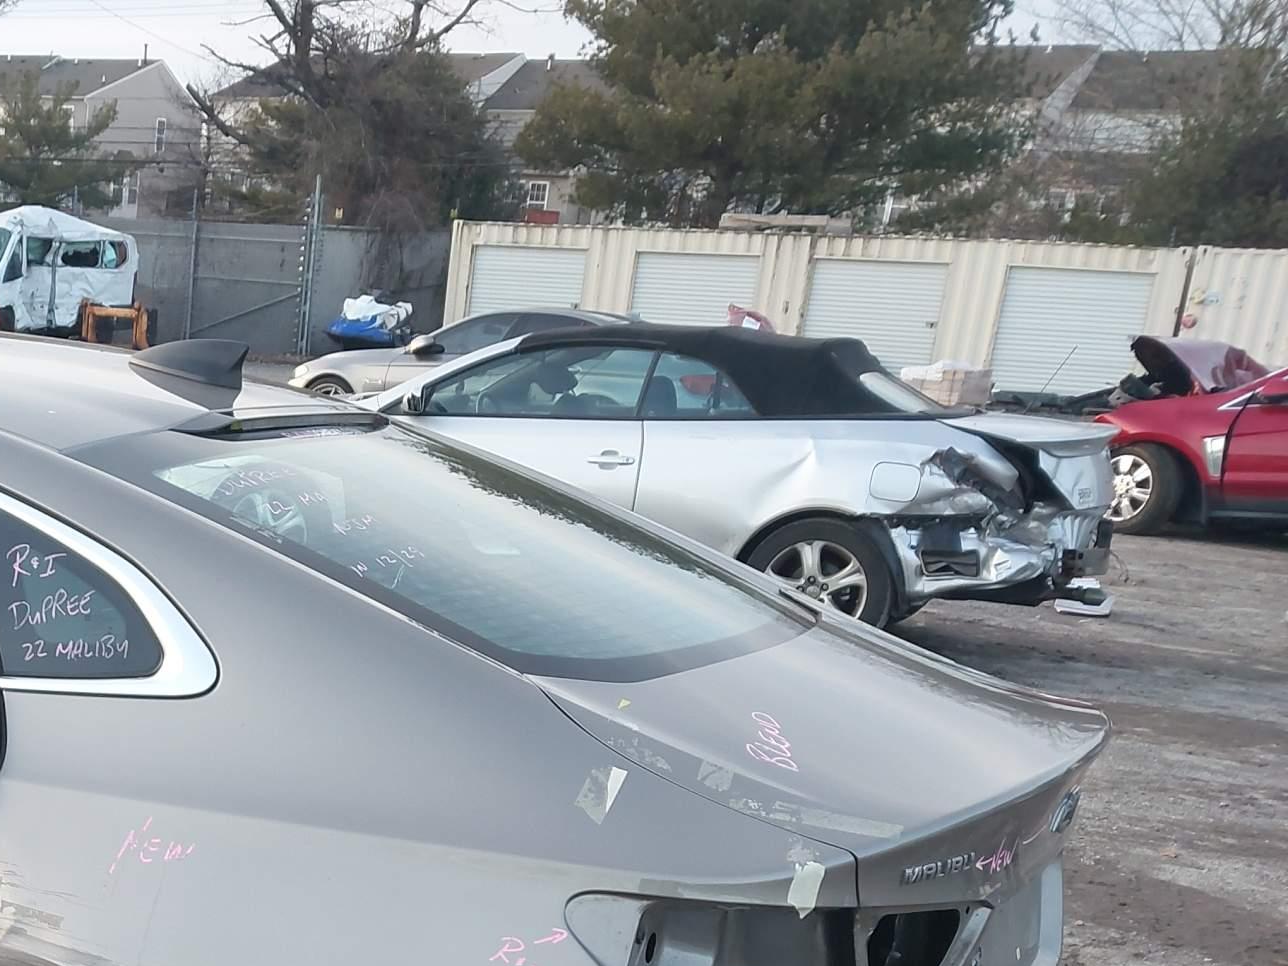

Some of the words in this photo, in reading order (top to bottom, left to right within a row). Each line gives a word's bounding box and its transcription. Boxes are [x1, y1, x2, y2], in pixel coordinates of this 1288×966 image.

[6, 543, 67, 587] R&I
[22, 640, 48, 661] 22
[746, 711, 799, 772] BLEND
[901, 852, 976, 883] MALIBU
